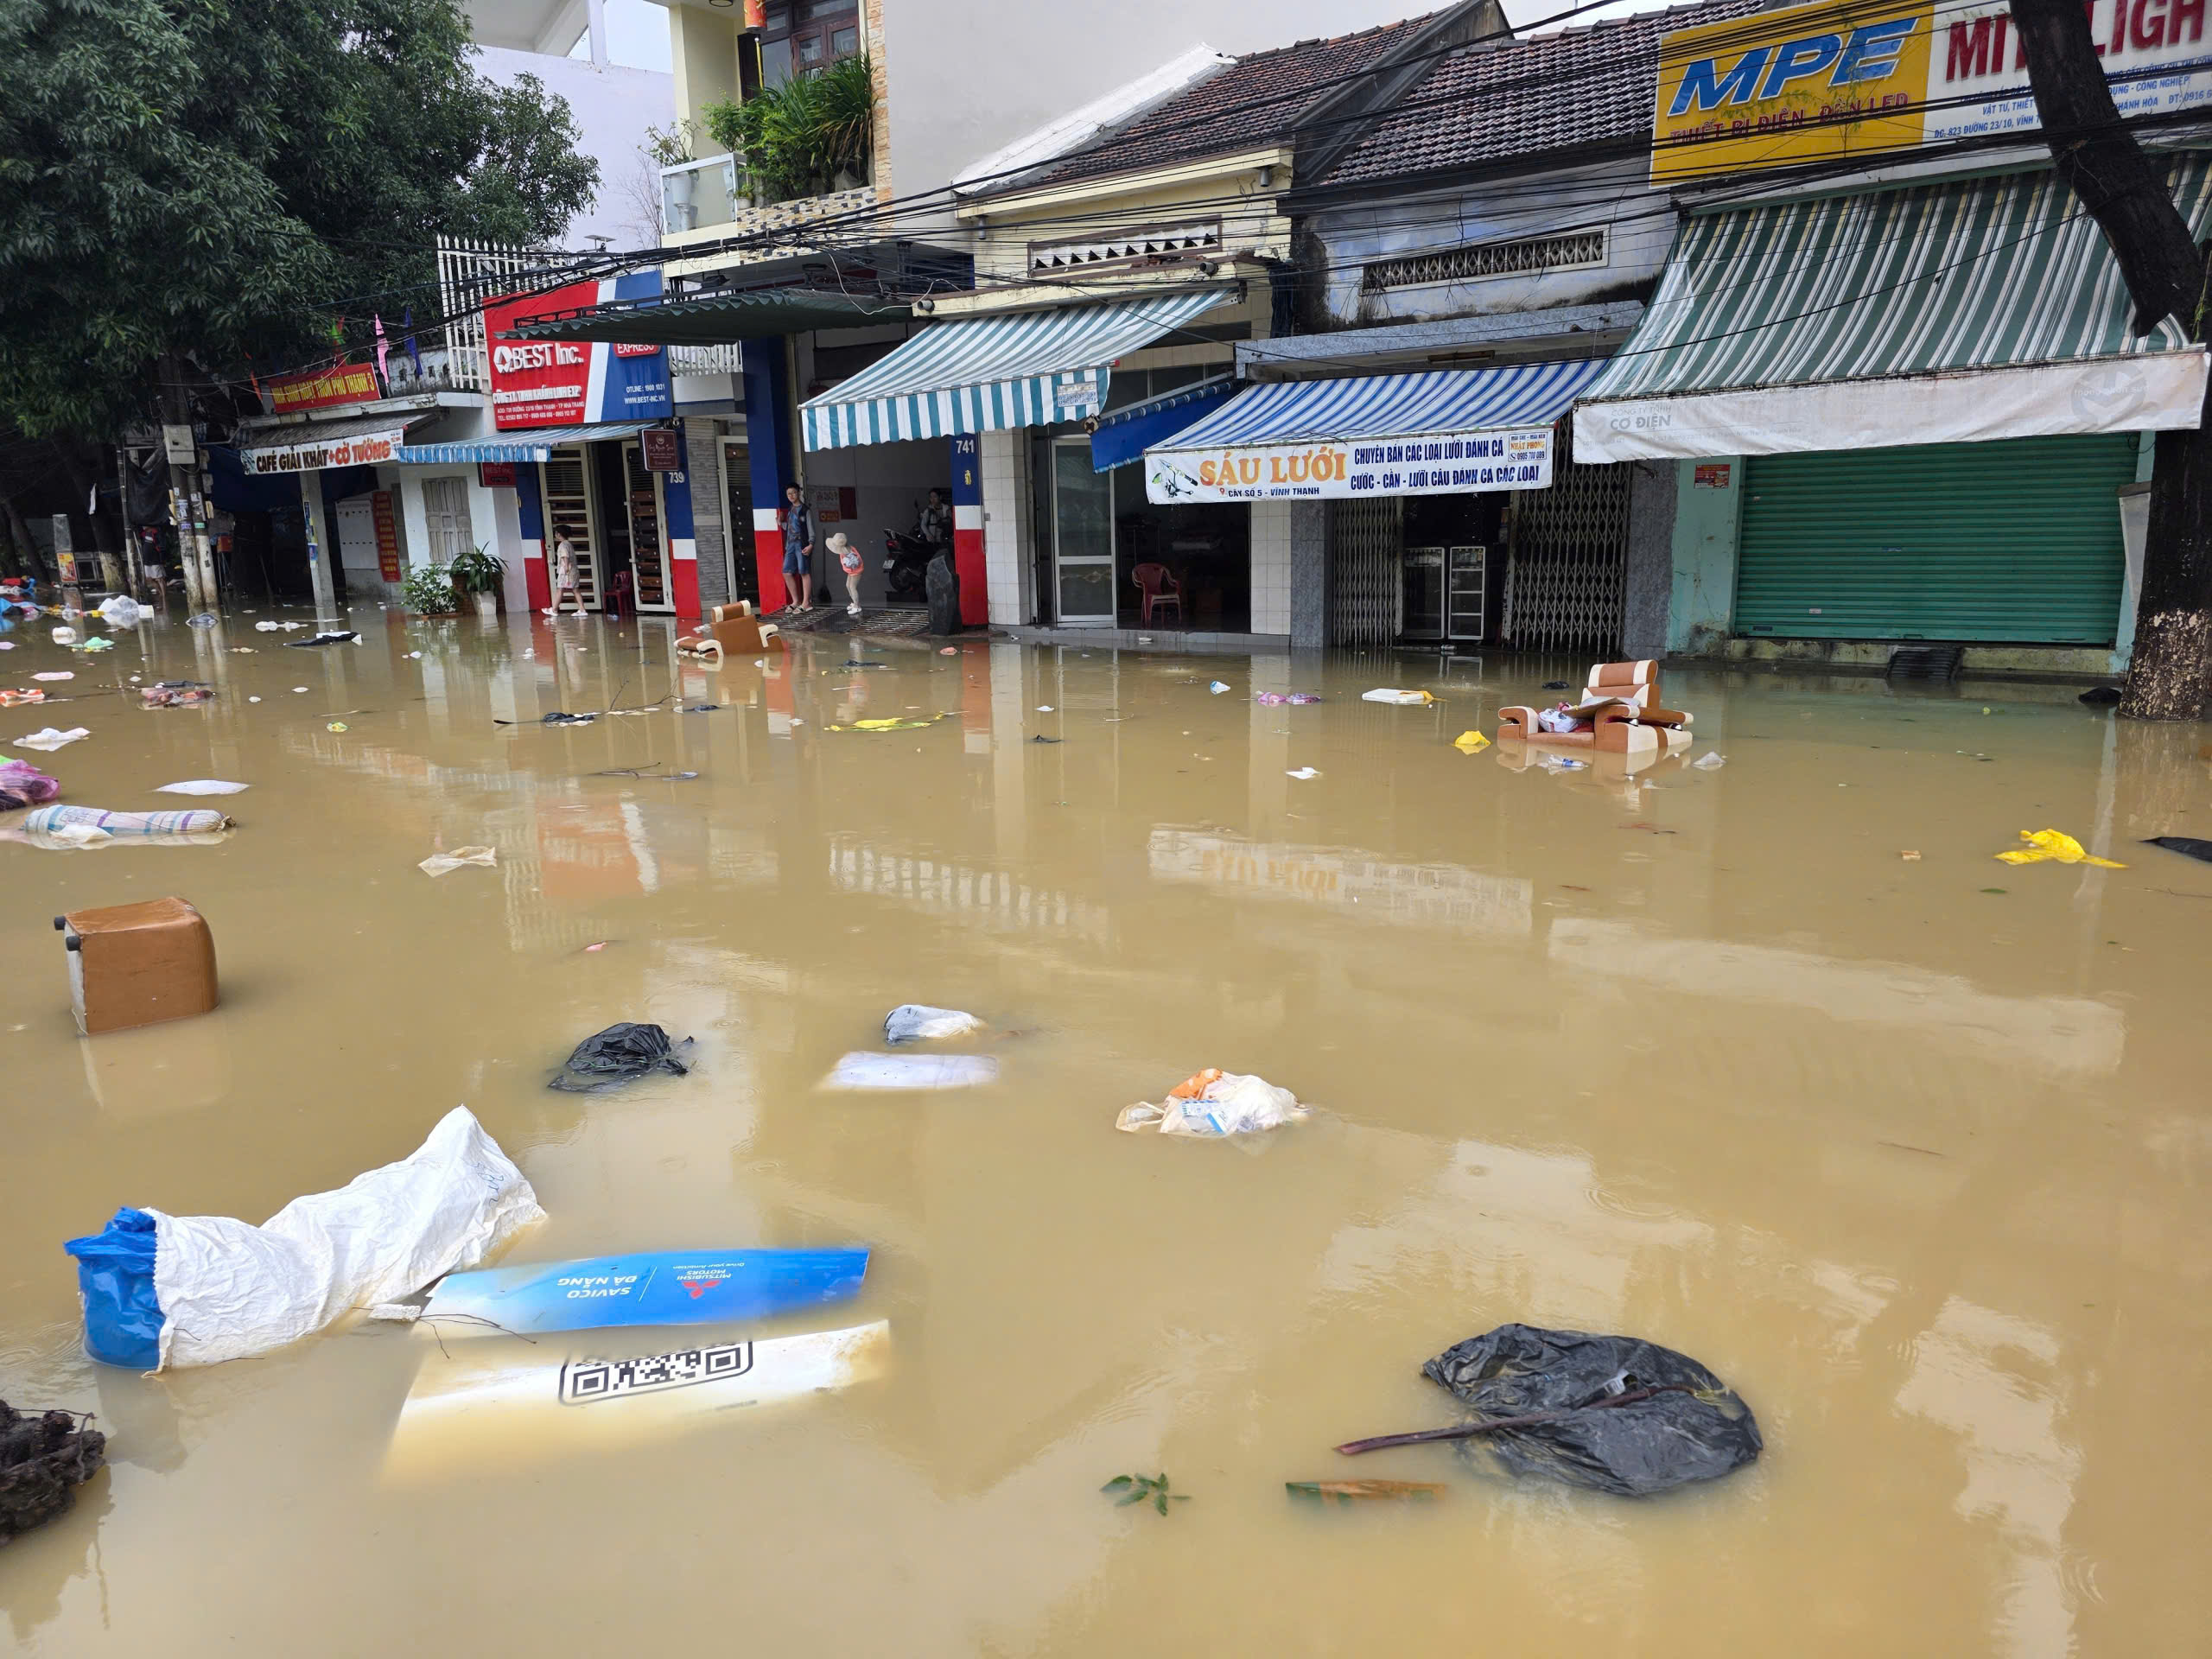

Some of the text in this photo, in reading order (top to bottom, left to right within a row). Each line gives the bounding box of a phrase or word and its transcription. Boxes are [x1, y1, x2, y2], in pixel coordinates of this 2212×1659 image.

[1667, 16, 1919, 118] MPE
[1869, 92, 1909, 115] LED
[1948, 126, 1962, 137] 823
[511, 342, 585, 371] BEST Inc.
[367, 372, 375, 391] 3
[1610, 413, 1671, 431] CƠ ĐIỆN
[956, 439, 975, 454] 741
[1355, 444, 1384, 465] CHUYÊN
[1387, 443, 1403, 463] BÁN
[1405, 442, 1422, 461] CÁC
[1424, 442, 1442, 463] LOẠI
[1465, 438, 1489, 459] ĐÁNH
[1491, 436, 1503, 457] CÁ
[1198, 446, 1348, 486] SÁU LƯỚI
[668, 471, 685, 484] 739
[1382, 467, 1401, 489] CẦN
[1431, 467, 1450, 486] CÂU
[1452, 467, 1478, 486] ĐÁNH
[1480, 465, 1494, 484] CÁ
[1496, 464, 1516, 483] CÁC
[1516, 465, 1540, 485] LOẠI
[1228, 488, 1243, 497] CÂY
[1244, 486, 1255, 497] SỐ
[1270, 487, 1290, 496] VĨNH
[1293, 487, 1319, 497] THẠNH
[613, 1274, 638, 1287] ĐÀ
[567, 1287, 632, 1299] SAVICO
